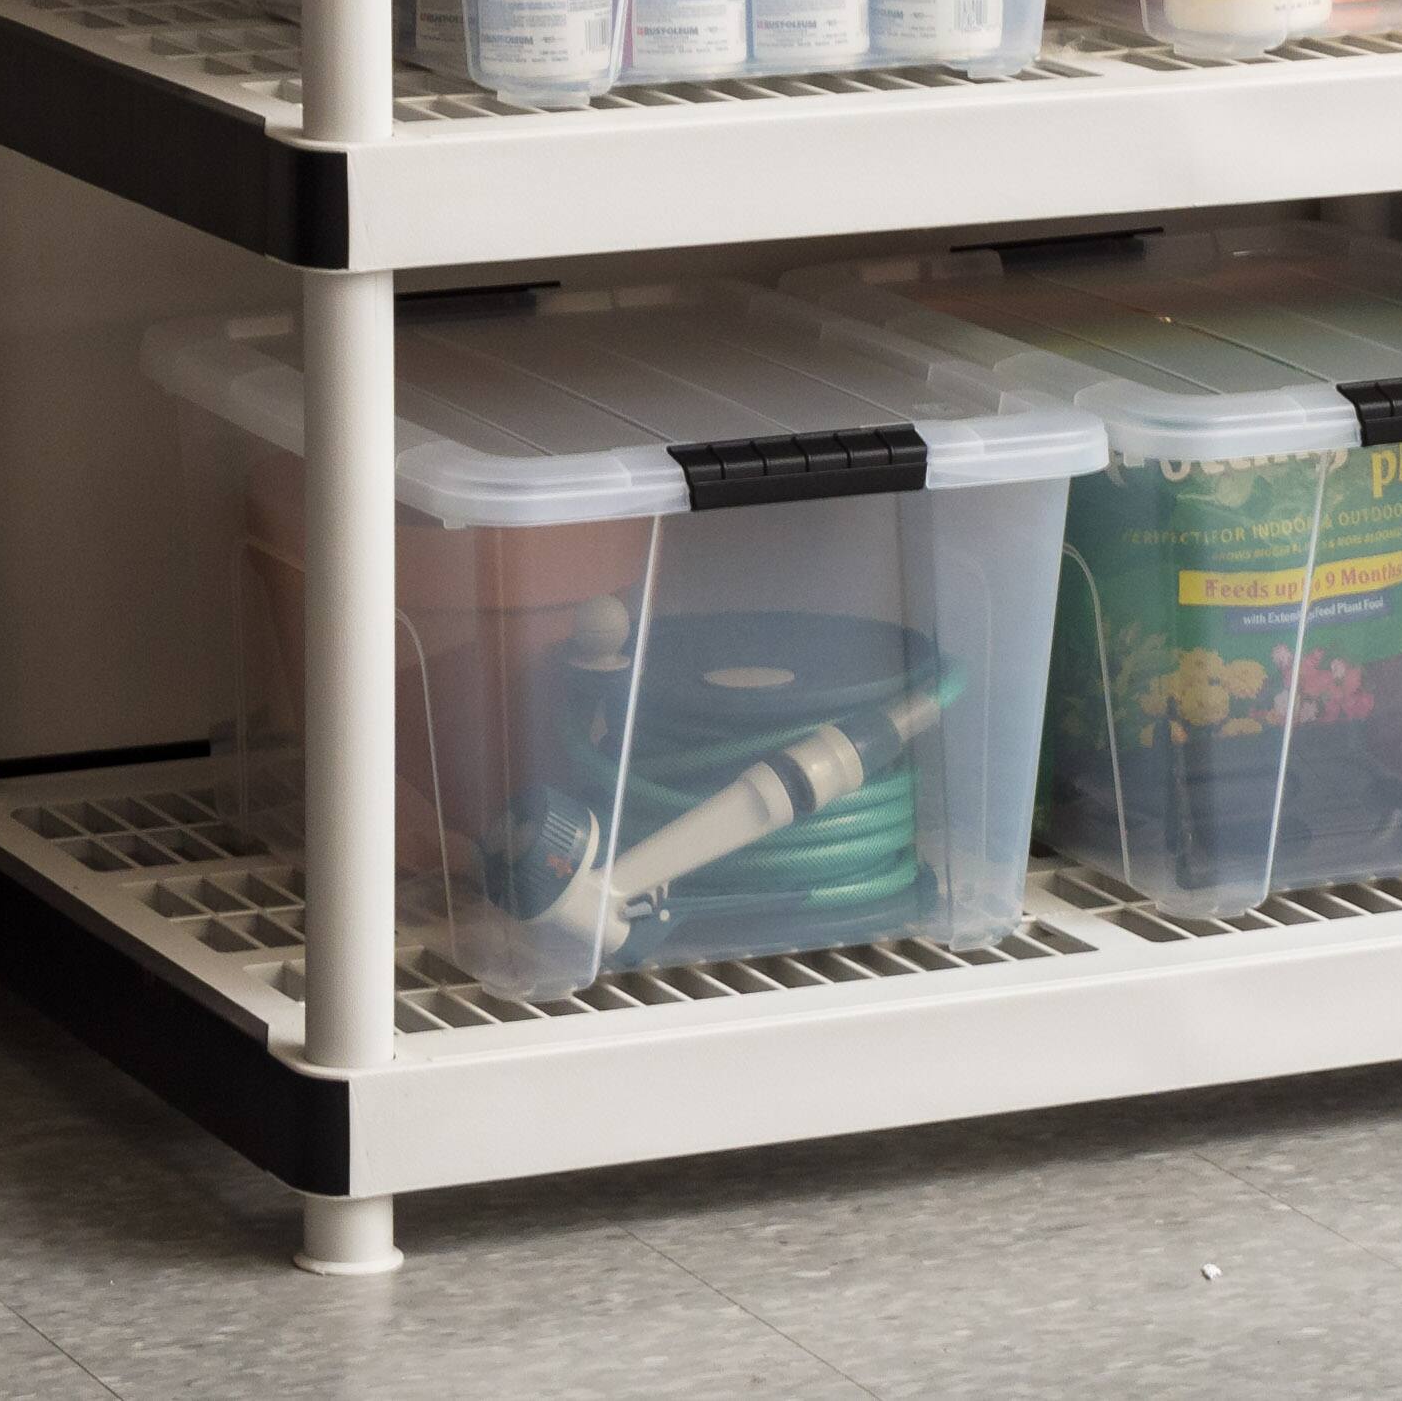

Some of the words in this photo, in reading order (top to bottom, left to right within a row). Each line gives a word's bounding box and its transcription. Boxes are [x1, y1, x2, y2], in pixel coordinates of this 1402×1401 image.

[1274, 581, 1298, 606] up
[1325, 573, 1336, 592] 9
[1242, 613, 1267, 626] with
